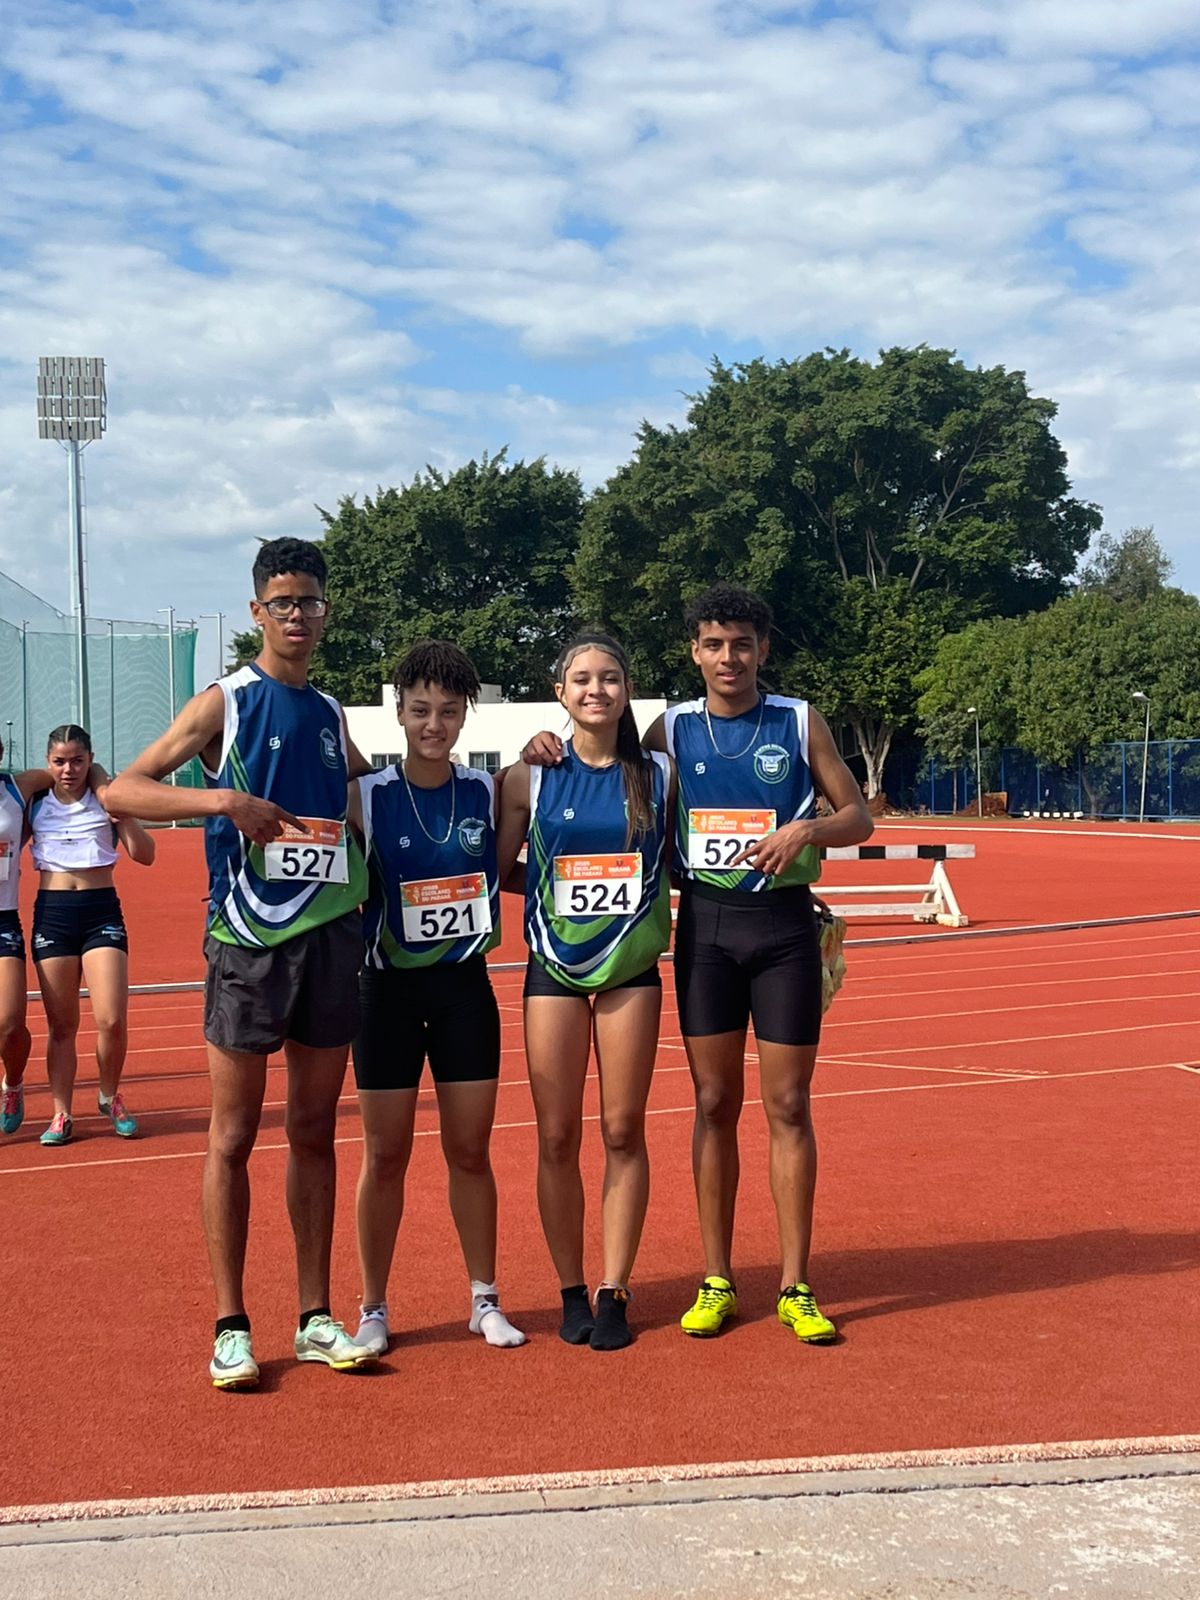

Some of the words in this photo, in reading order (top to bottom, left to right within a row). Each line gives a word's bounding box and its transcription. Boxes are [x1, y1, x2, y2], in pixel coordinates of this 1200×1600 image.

[281, 847, 336, 878] 527
[570, 883, 631, 913] 524
[420, 904, 475, 938] 521
